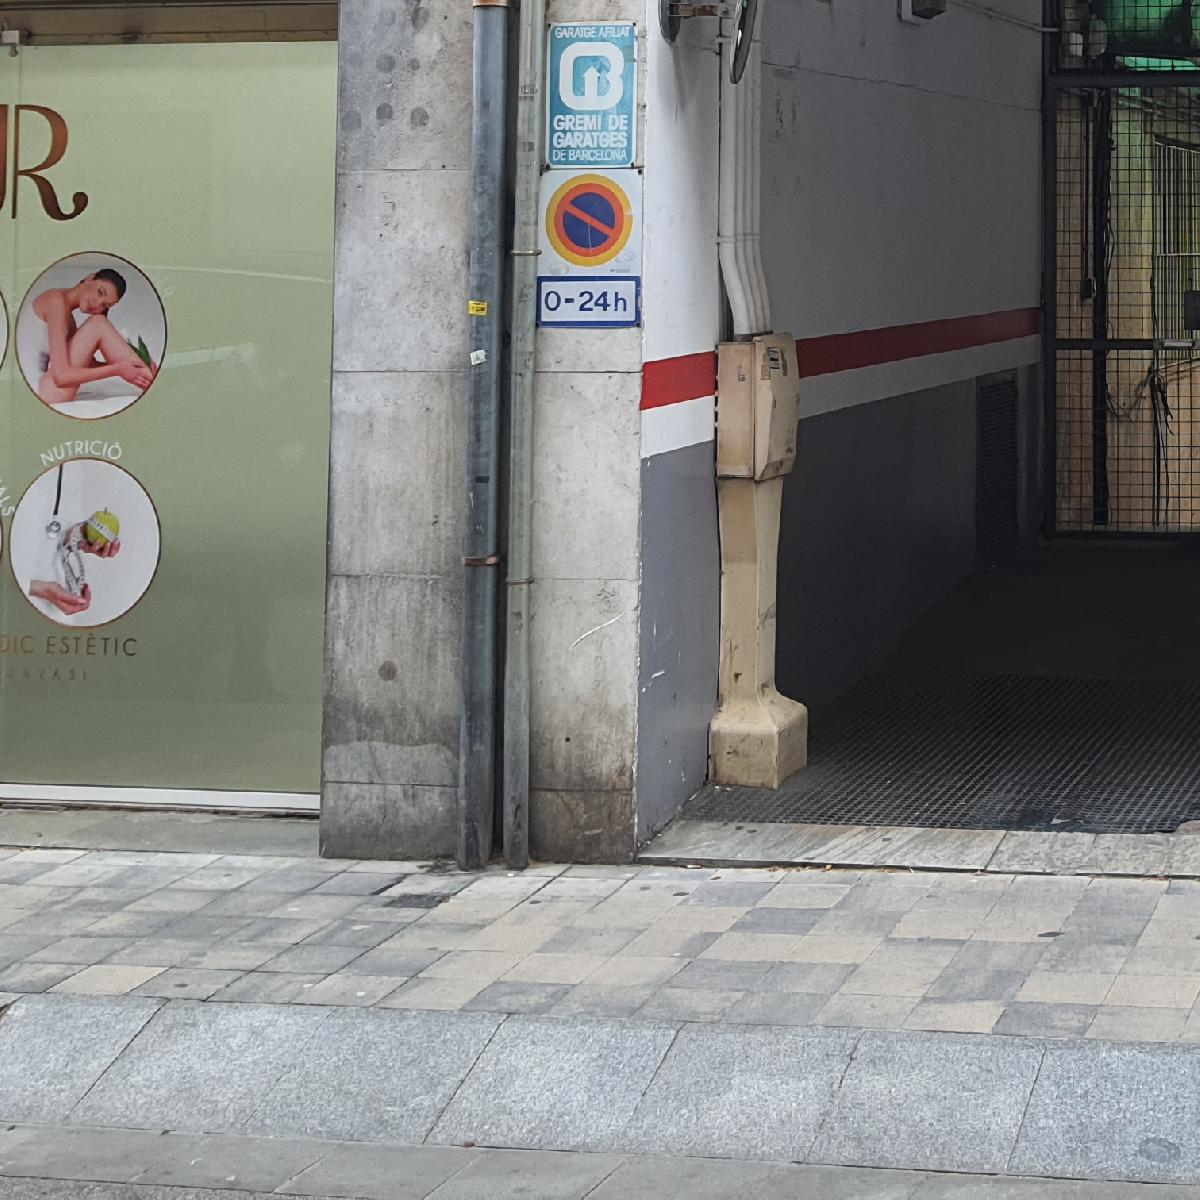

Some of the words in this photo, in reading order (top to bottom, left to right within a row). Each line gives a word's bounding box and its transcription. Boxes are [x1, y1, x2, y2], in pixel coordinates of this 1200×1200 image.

[554, 27, 597, 39] GARATGE
[599, 26, 631, 38] AFILIAT
[553, 114, 601, 131] GREMI
[608, 114, 628, 131] DE
[552, 131, 628, 149] GARATGES
[552, 150, 566, 161] DE
[568, 149, 628, 161] BARCELONA
[40, 440, 122, 466] NUTRICIÓ
[45, 633, 139, 657] ESTÈTIC
